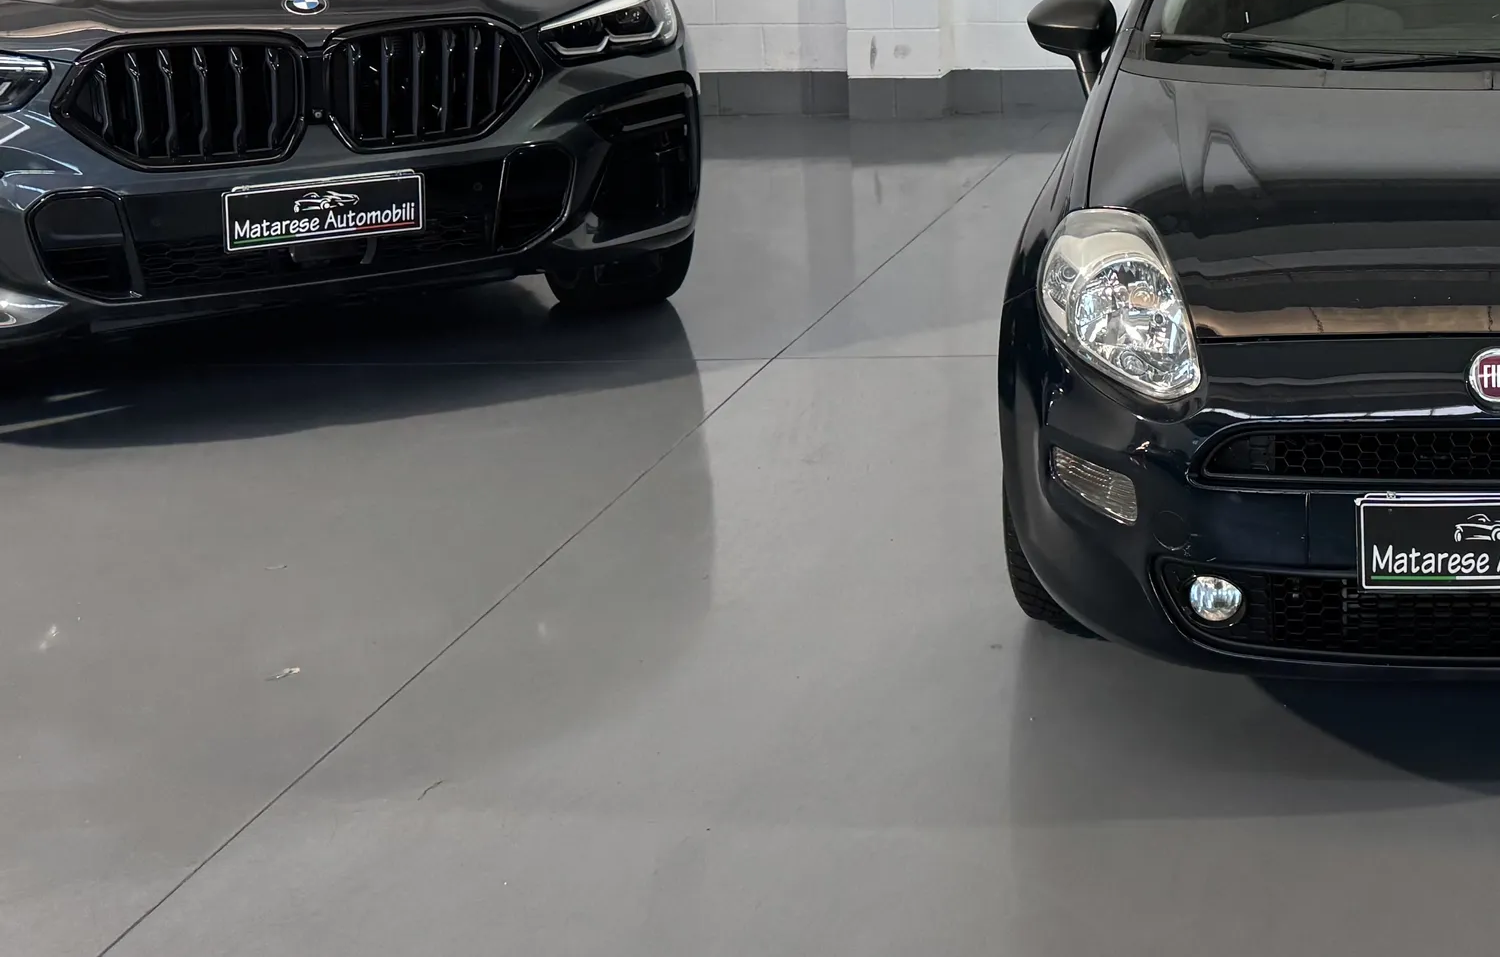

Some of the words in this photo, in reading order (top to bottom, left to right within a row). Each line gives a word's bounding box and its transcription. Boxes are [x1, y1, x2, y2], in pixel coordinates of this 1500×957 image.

[234, 216, 320, 240] Matarese
[324, 202, 416, 230] Automobili
[1371, 544, 1490, 574] Matarese
